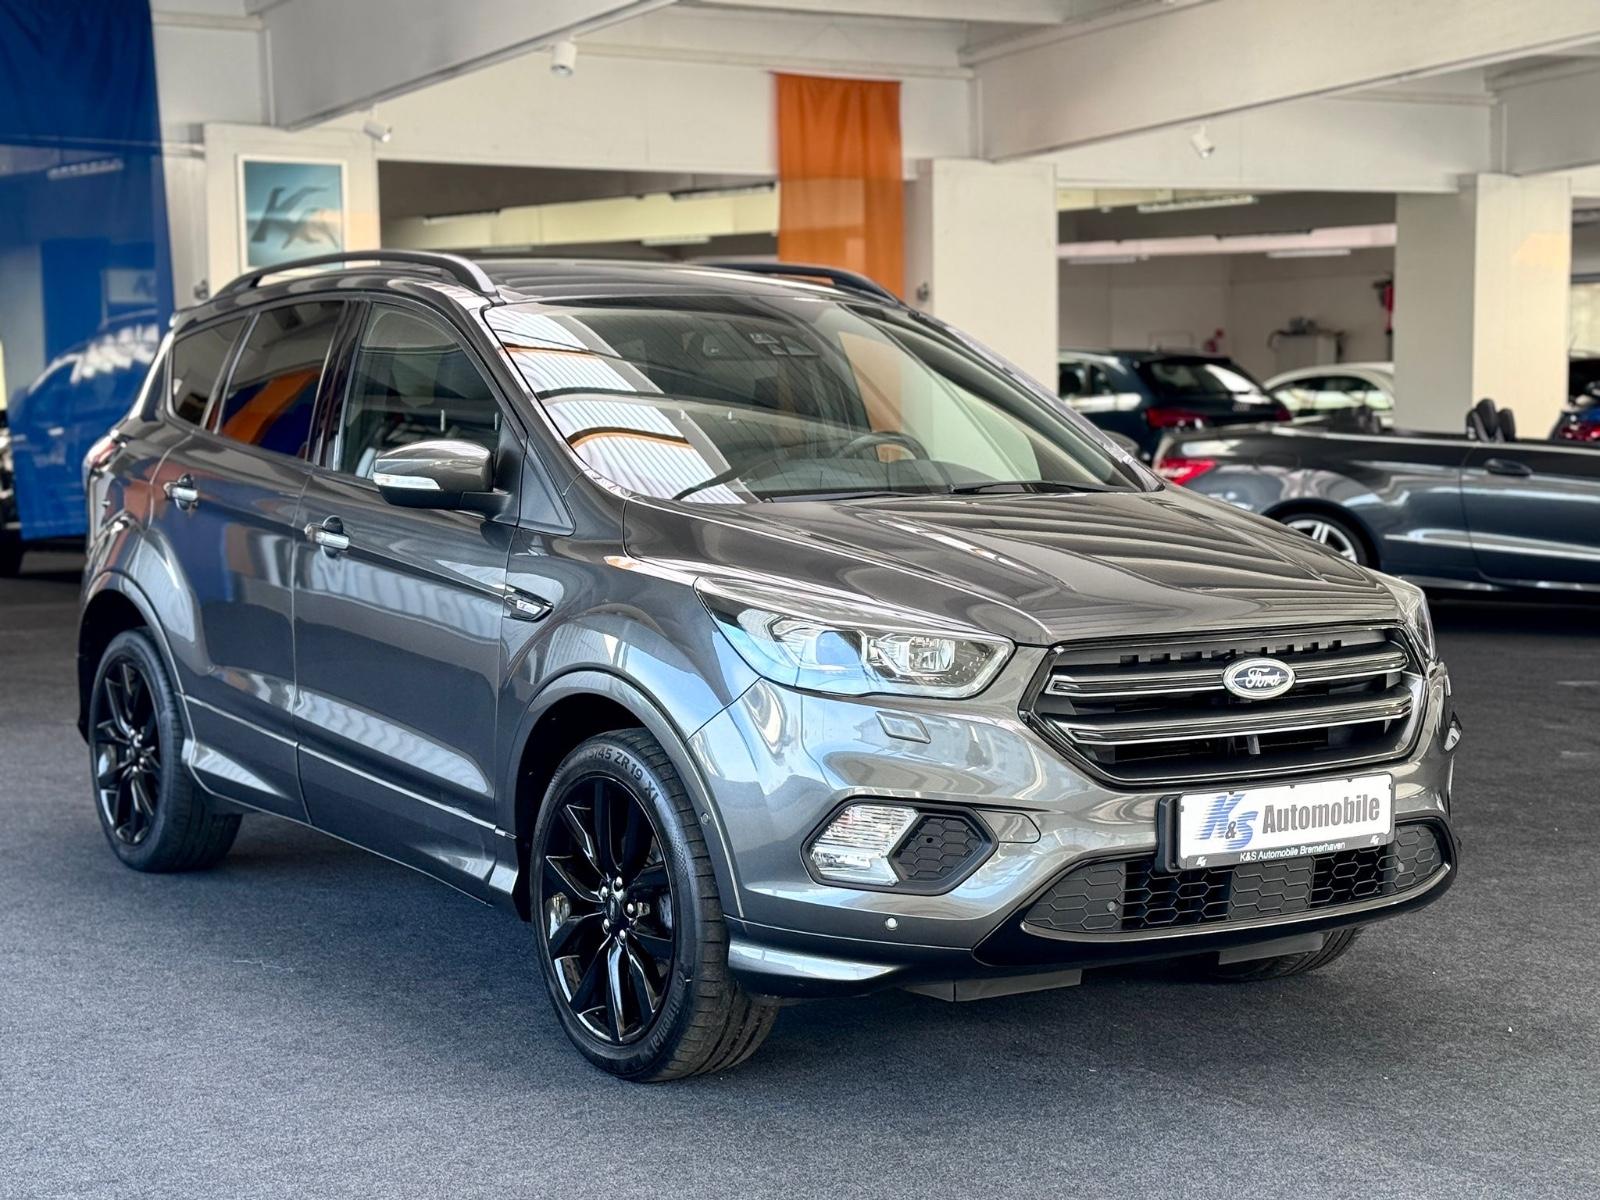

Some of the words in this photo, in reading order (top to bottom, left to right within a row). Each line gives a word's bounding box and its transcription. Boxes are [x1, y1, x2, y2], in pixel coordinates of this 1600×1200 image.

[1238, 667, 1281, 688] Ford
[1196, 794, 1258, 849] K&S
[1262, 794, 1380, 834] Automobile
[1240, 851, 1257, 862] K&S
[1258, 847, 1298, 860] Automobile
[1300, 842, 1345, 855] Bremerhaven
